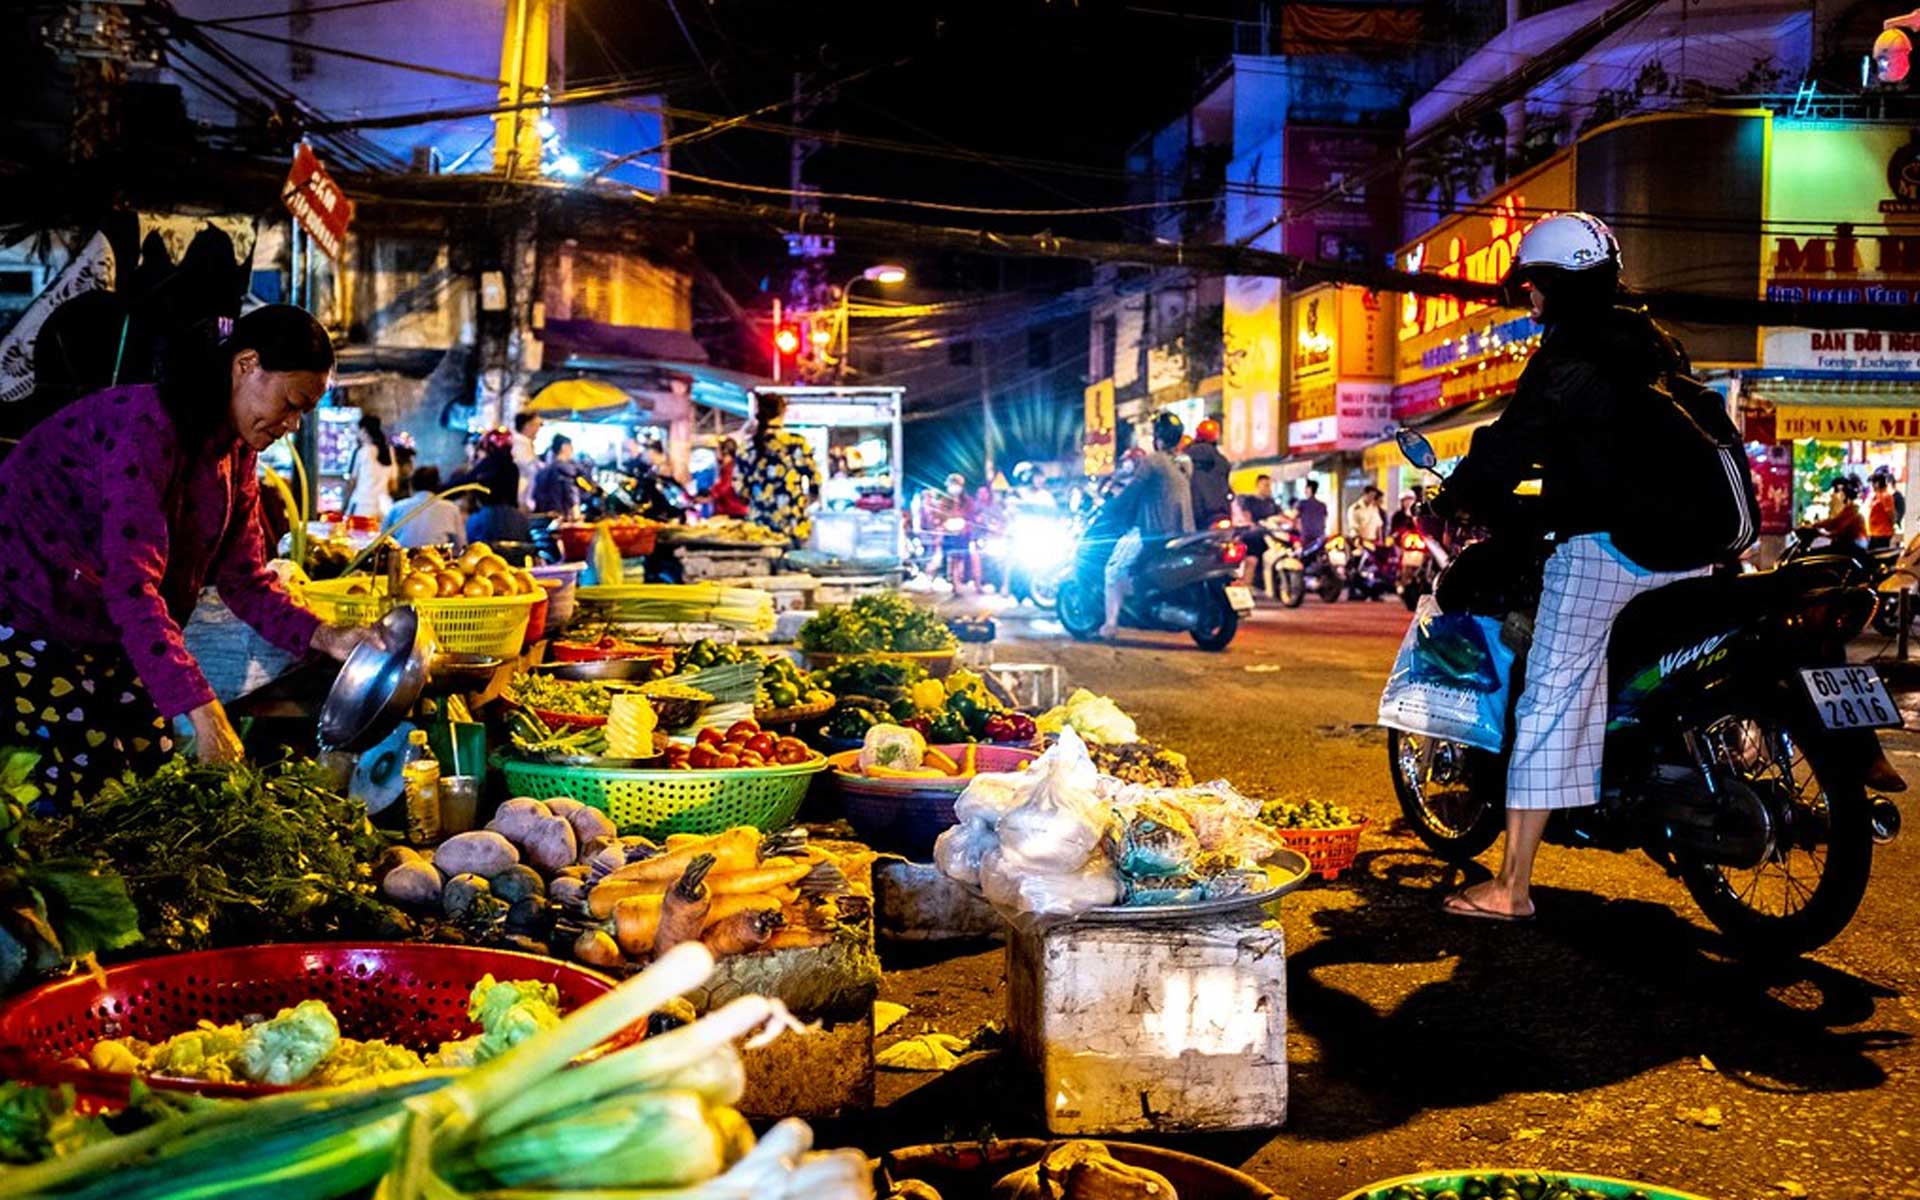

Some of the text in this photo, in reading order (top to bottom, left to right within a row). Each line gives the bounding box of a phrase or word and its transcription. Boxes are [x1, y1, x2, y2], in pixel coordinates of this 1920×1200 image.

[1818, 356, 1912, 370] Foreign Exchange
[1658, 633, 1727, 678] Wave
[1696, 648, 1728, 672] 110
[1811, 669, 1875, 697] 60-H3
[1825, 698, 1888, 727] 2816
